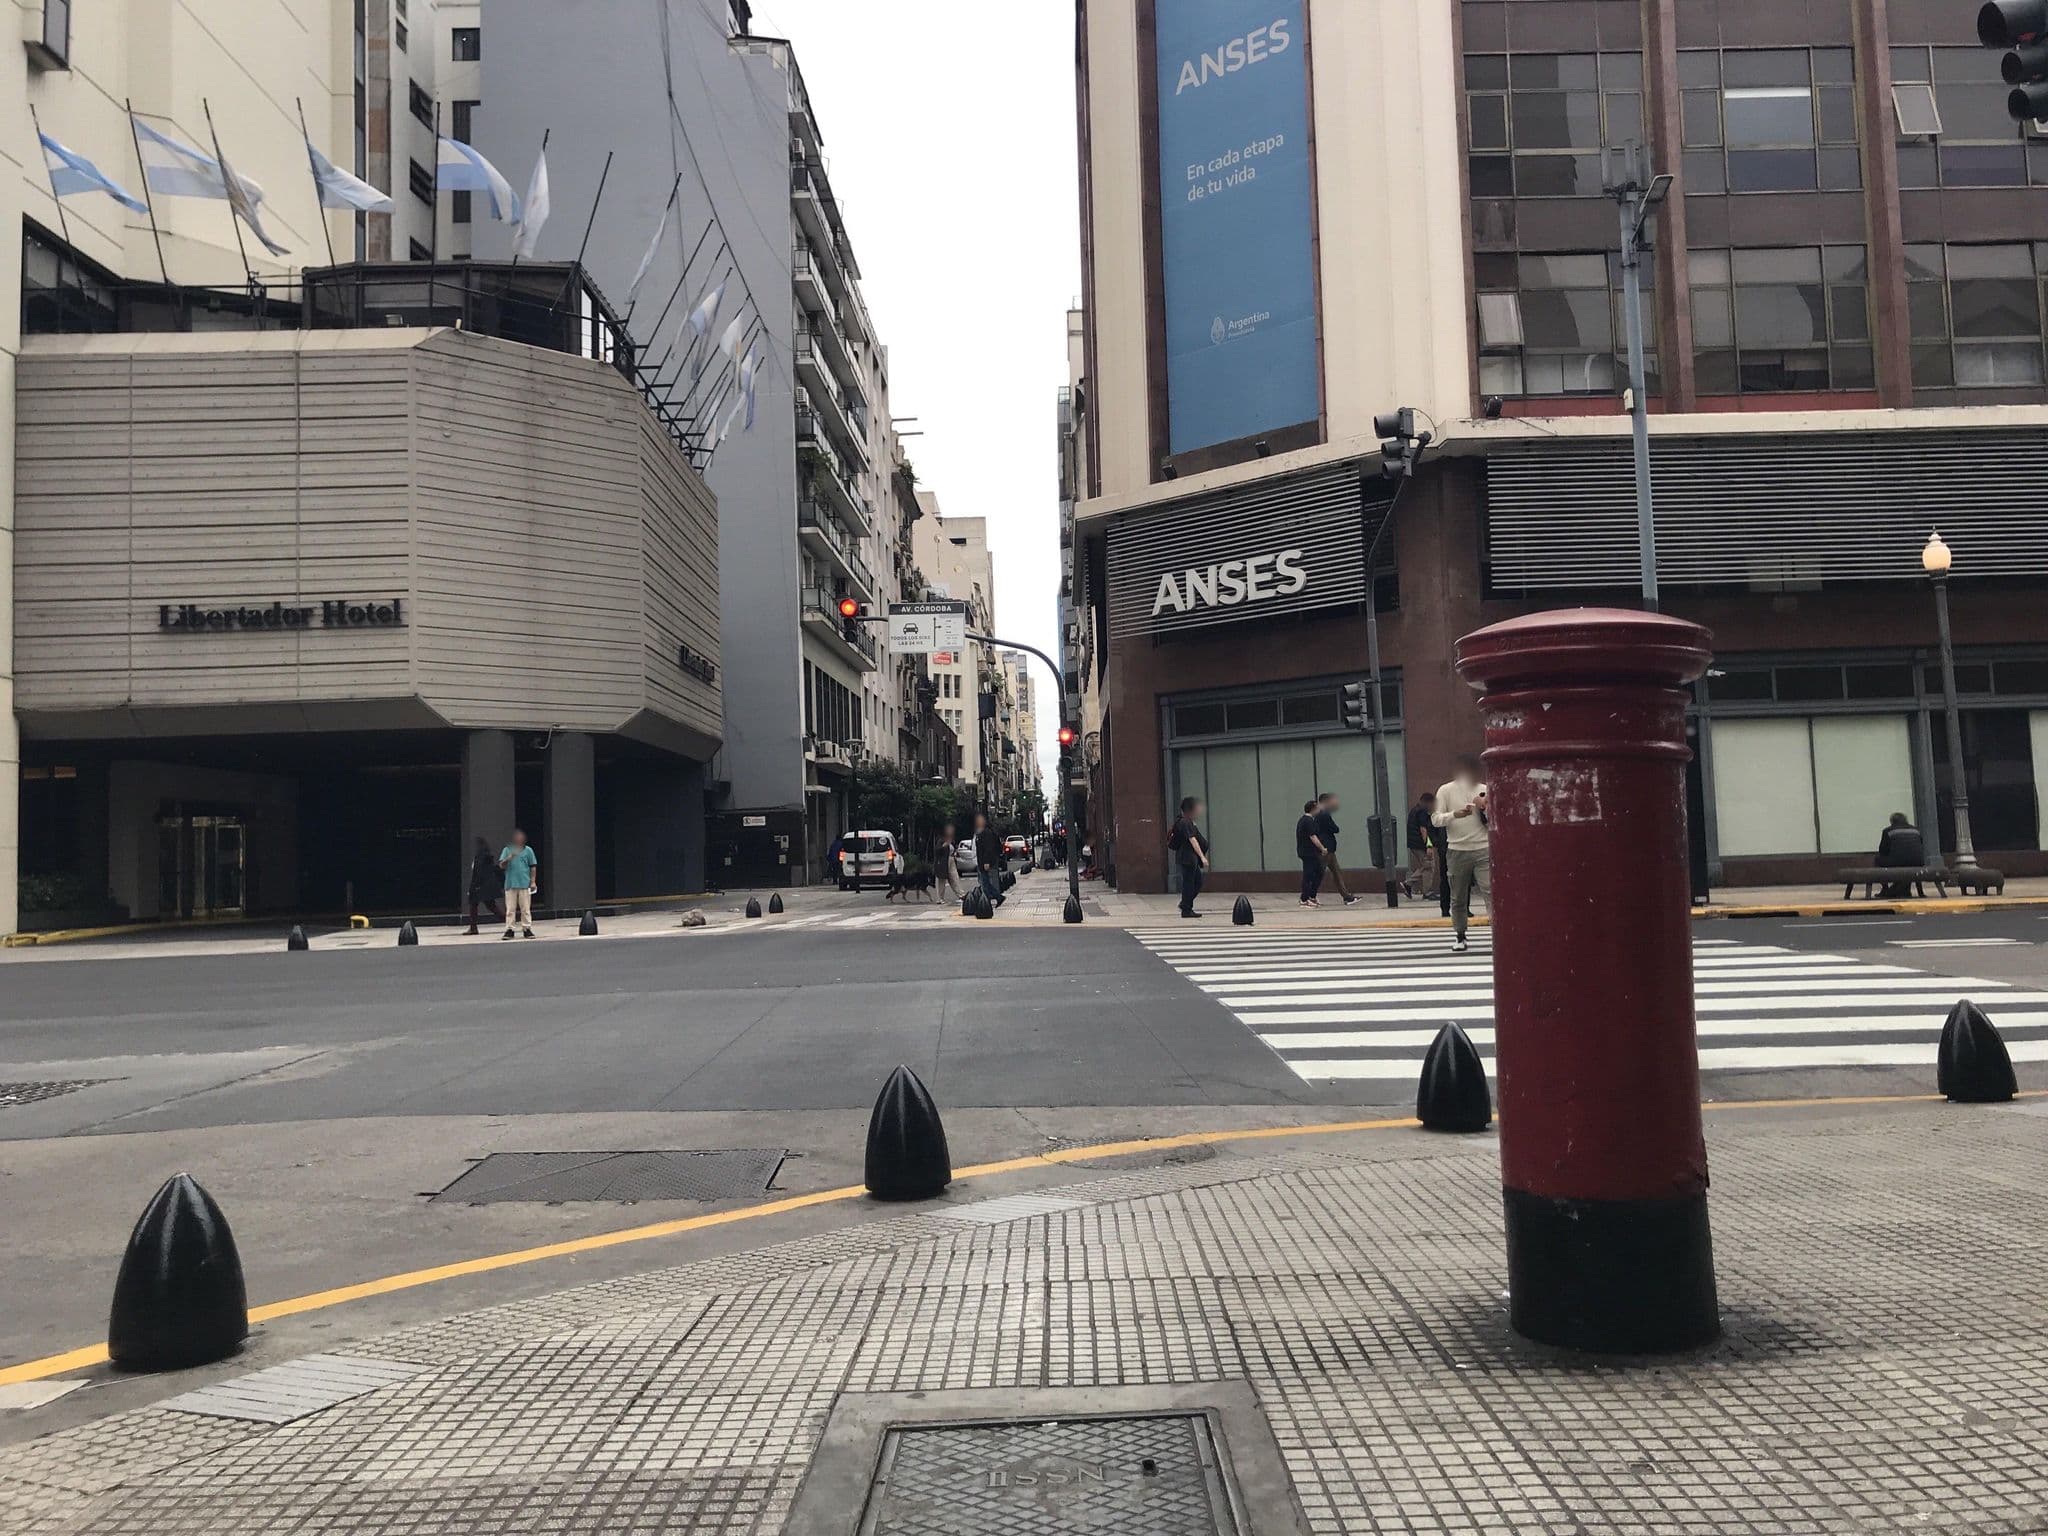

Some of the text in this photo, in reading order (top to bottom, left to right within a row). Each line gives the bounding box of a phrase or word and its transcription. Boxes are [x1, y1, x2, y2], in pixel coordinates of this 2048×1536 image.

[1175, 18, 1291, 95] ANSES
[1187, 133, 1284, 181] En cada etapa
[1187, 164, 1256, 202] de tu vida
[1227, 310, 1270, 331] Argentina
[1151, 548, 1309, 617] ANSES
[158, 598, 402, 628] Libertador Hotel
